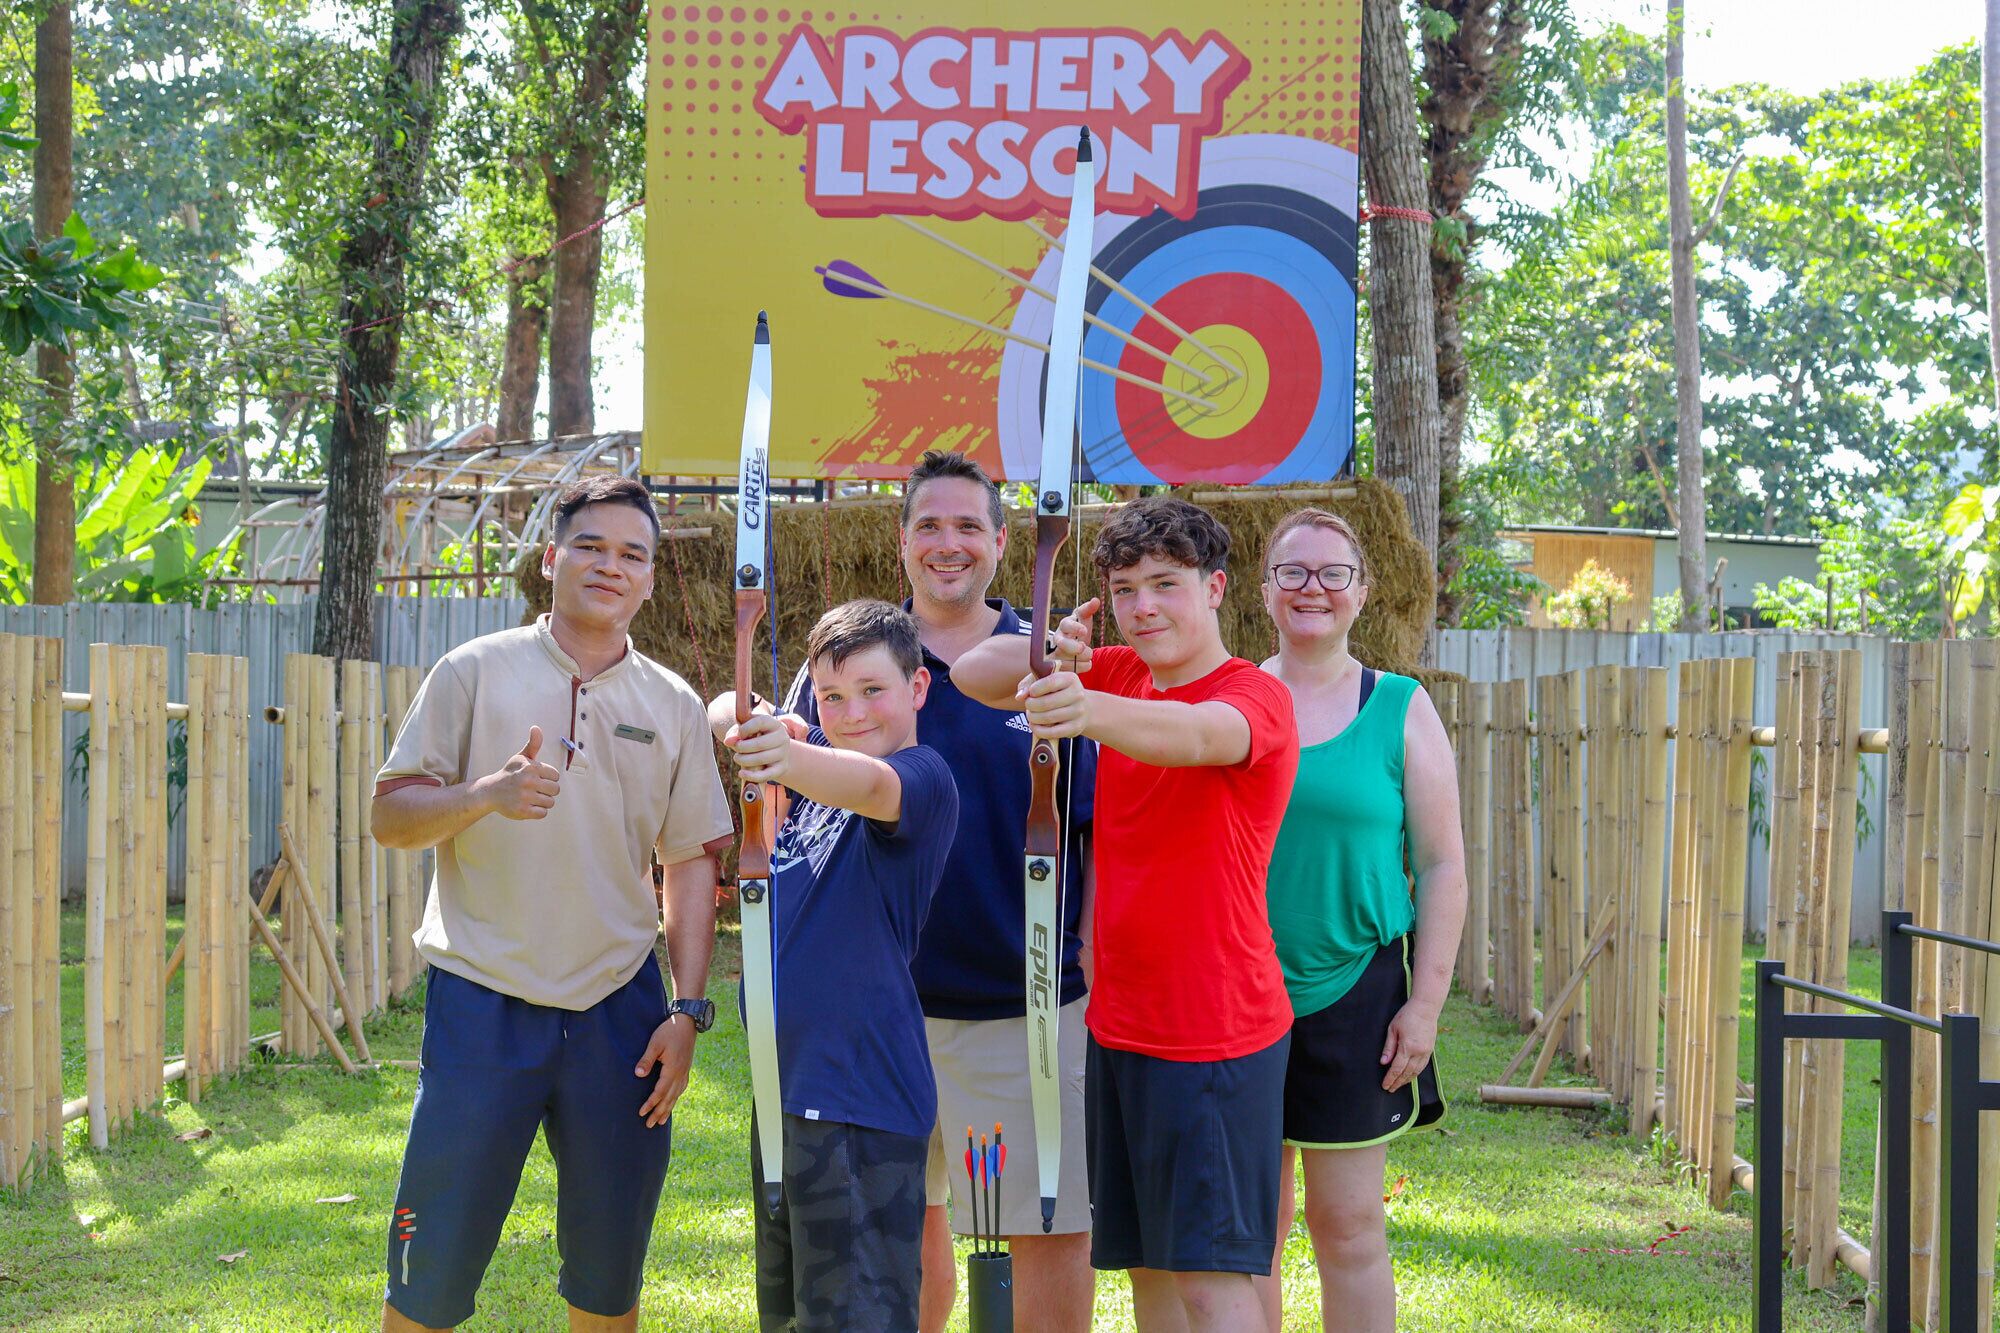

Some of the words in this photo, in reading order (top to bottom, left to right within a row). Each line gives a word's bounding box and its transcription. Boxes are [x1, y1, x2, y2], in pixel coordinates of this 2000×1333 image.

[763, 33, 1229, 115] ARCHERY
[815, 120, 1180, 200] LESSON
[744, 454, 762, 530] CARTEL
